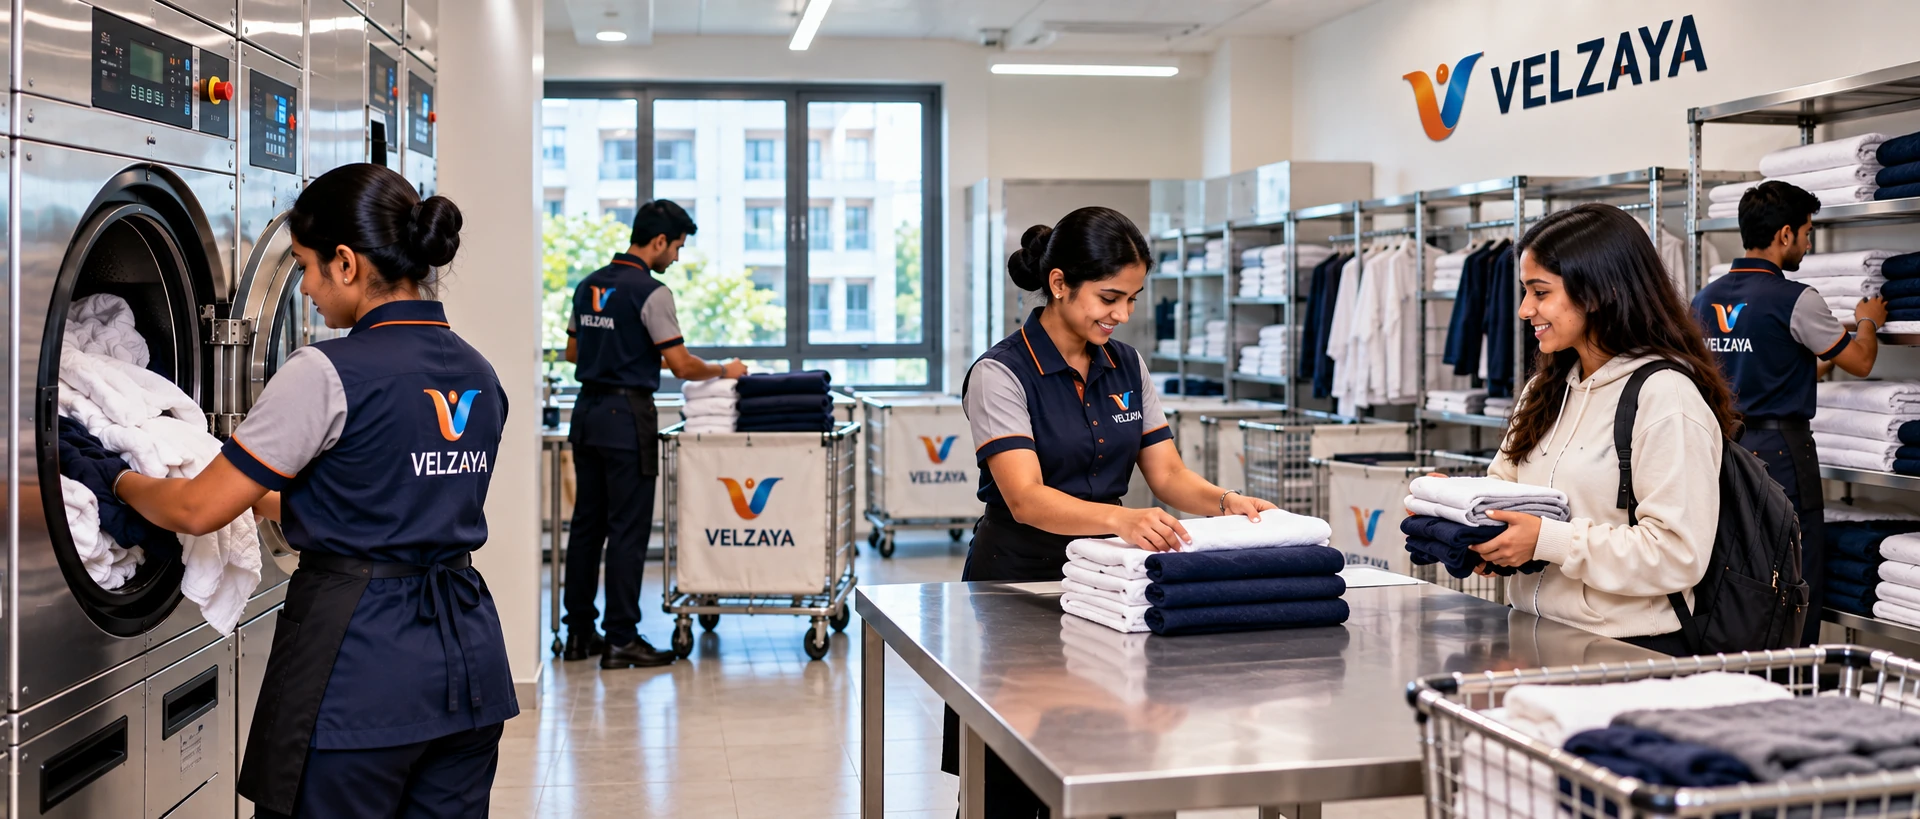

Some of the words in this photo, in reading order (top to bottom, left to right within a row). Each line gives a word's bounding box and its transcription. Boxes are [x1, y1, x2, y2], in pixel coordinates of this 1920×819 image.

[1490, 14, 1708, 114] VELZAYA
[580, 314, 615, 330] VELZAYA
[1702, 337, 1753, 352] VELZAYA
[410, 451, 488, 477] VELZAYA
[909, 470, 968, 484] VELZAYA
[704, 528, 795, 547] VELZAYA
